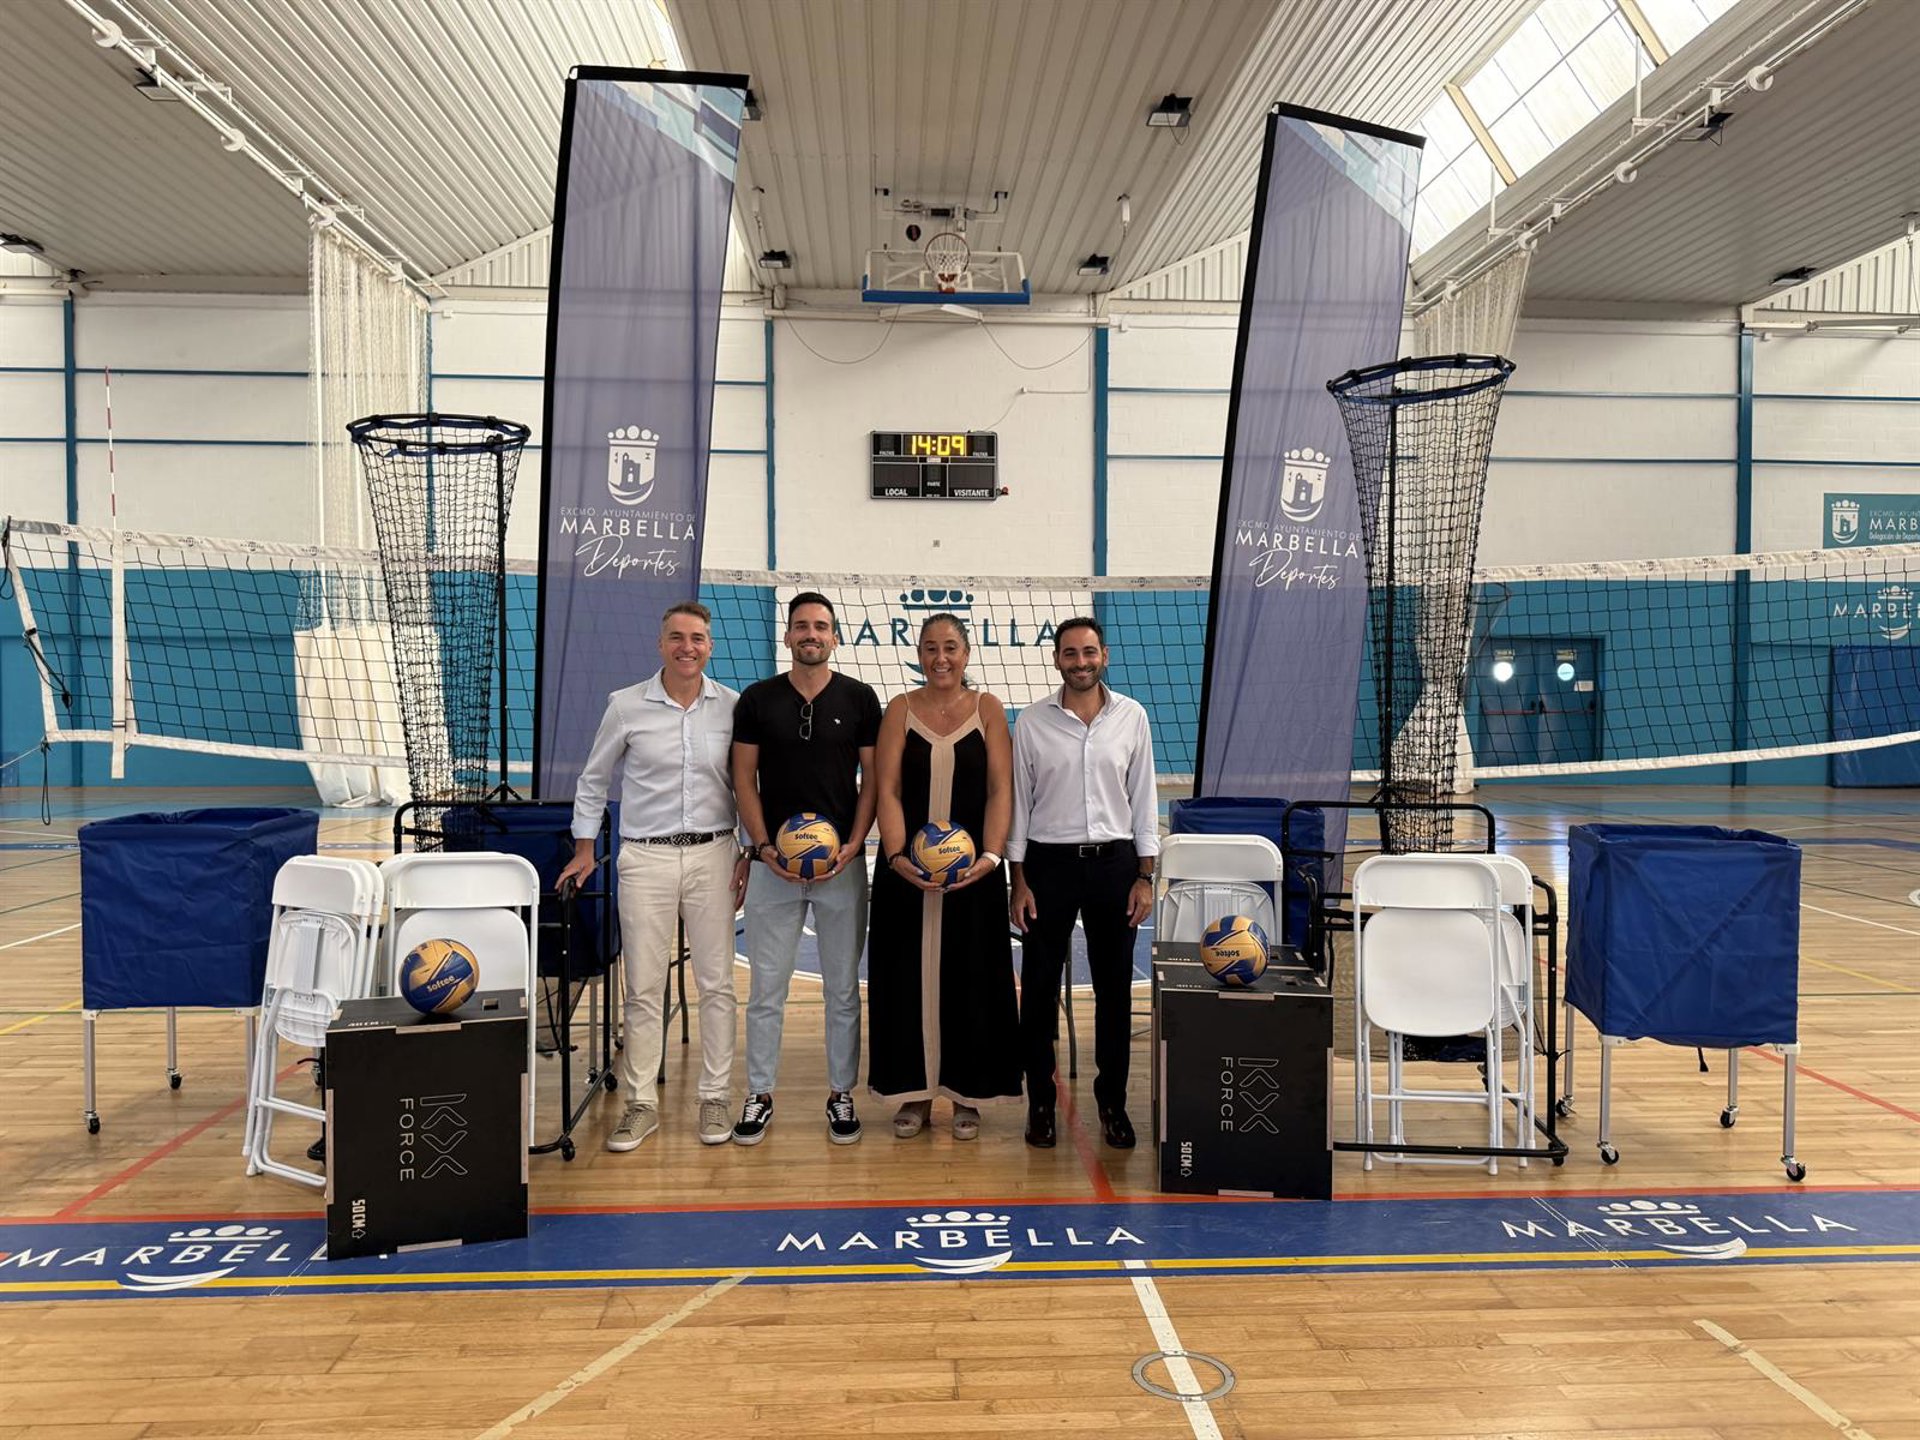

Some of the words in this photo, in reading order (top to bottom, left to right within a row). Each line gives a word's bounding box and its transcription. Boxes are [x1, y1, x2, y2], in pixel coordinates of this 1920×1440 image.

[912, 435, 965, 456] 14:09
[885, 488, 908, 497] LOCAL
[954, 489, 989, 498] VISITANTE
[602, 509, 684, 522] AYUNTAMIENTO
[560, 517, 695, 540] MARBELLA
[1273, 525, 1347, 540] AYUNTAMIENTO
[1348, 532, 1361, 541] DE
[1235, 529, 1358, 558] MARBELLA
[575, 534, 680, 580] Deportes
[1249, 548, 1340, 591] Deportes
[1833, 602, 1920, 619] MARBE
[836, 618, 1056, 647] ARLLA
[1215, 949, 1241, 957] Softee
[426, 973, 456, 993] Softee
[1220, 1056, 1234, 1132] FORCE
[399, 1097, 415, 1182] FORCE
[1180, 1141, 1193, 1168] 50CM
[351, 1199, 366, 1228] 50CM
[1501, 1213, 1858, 1239] MARBELLA
[776, 1226, 1146, 1252] MARBELLA
[2, 1245, 388, 1268] MARBELL
